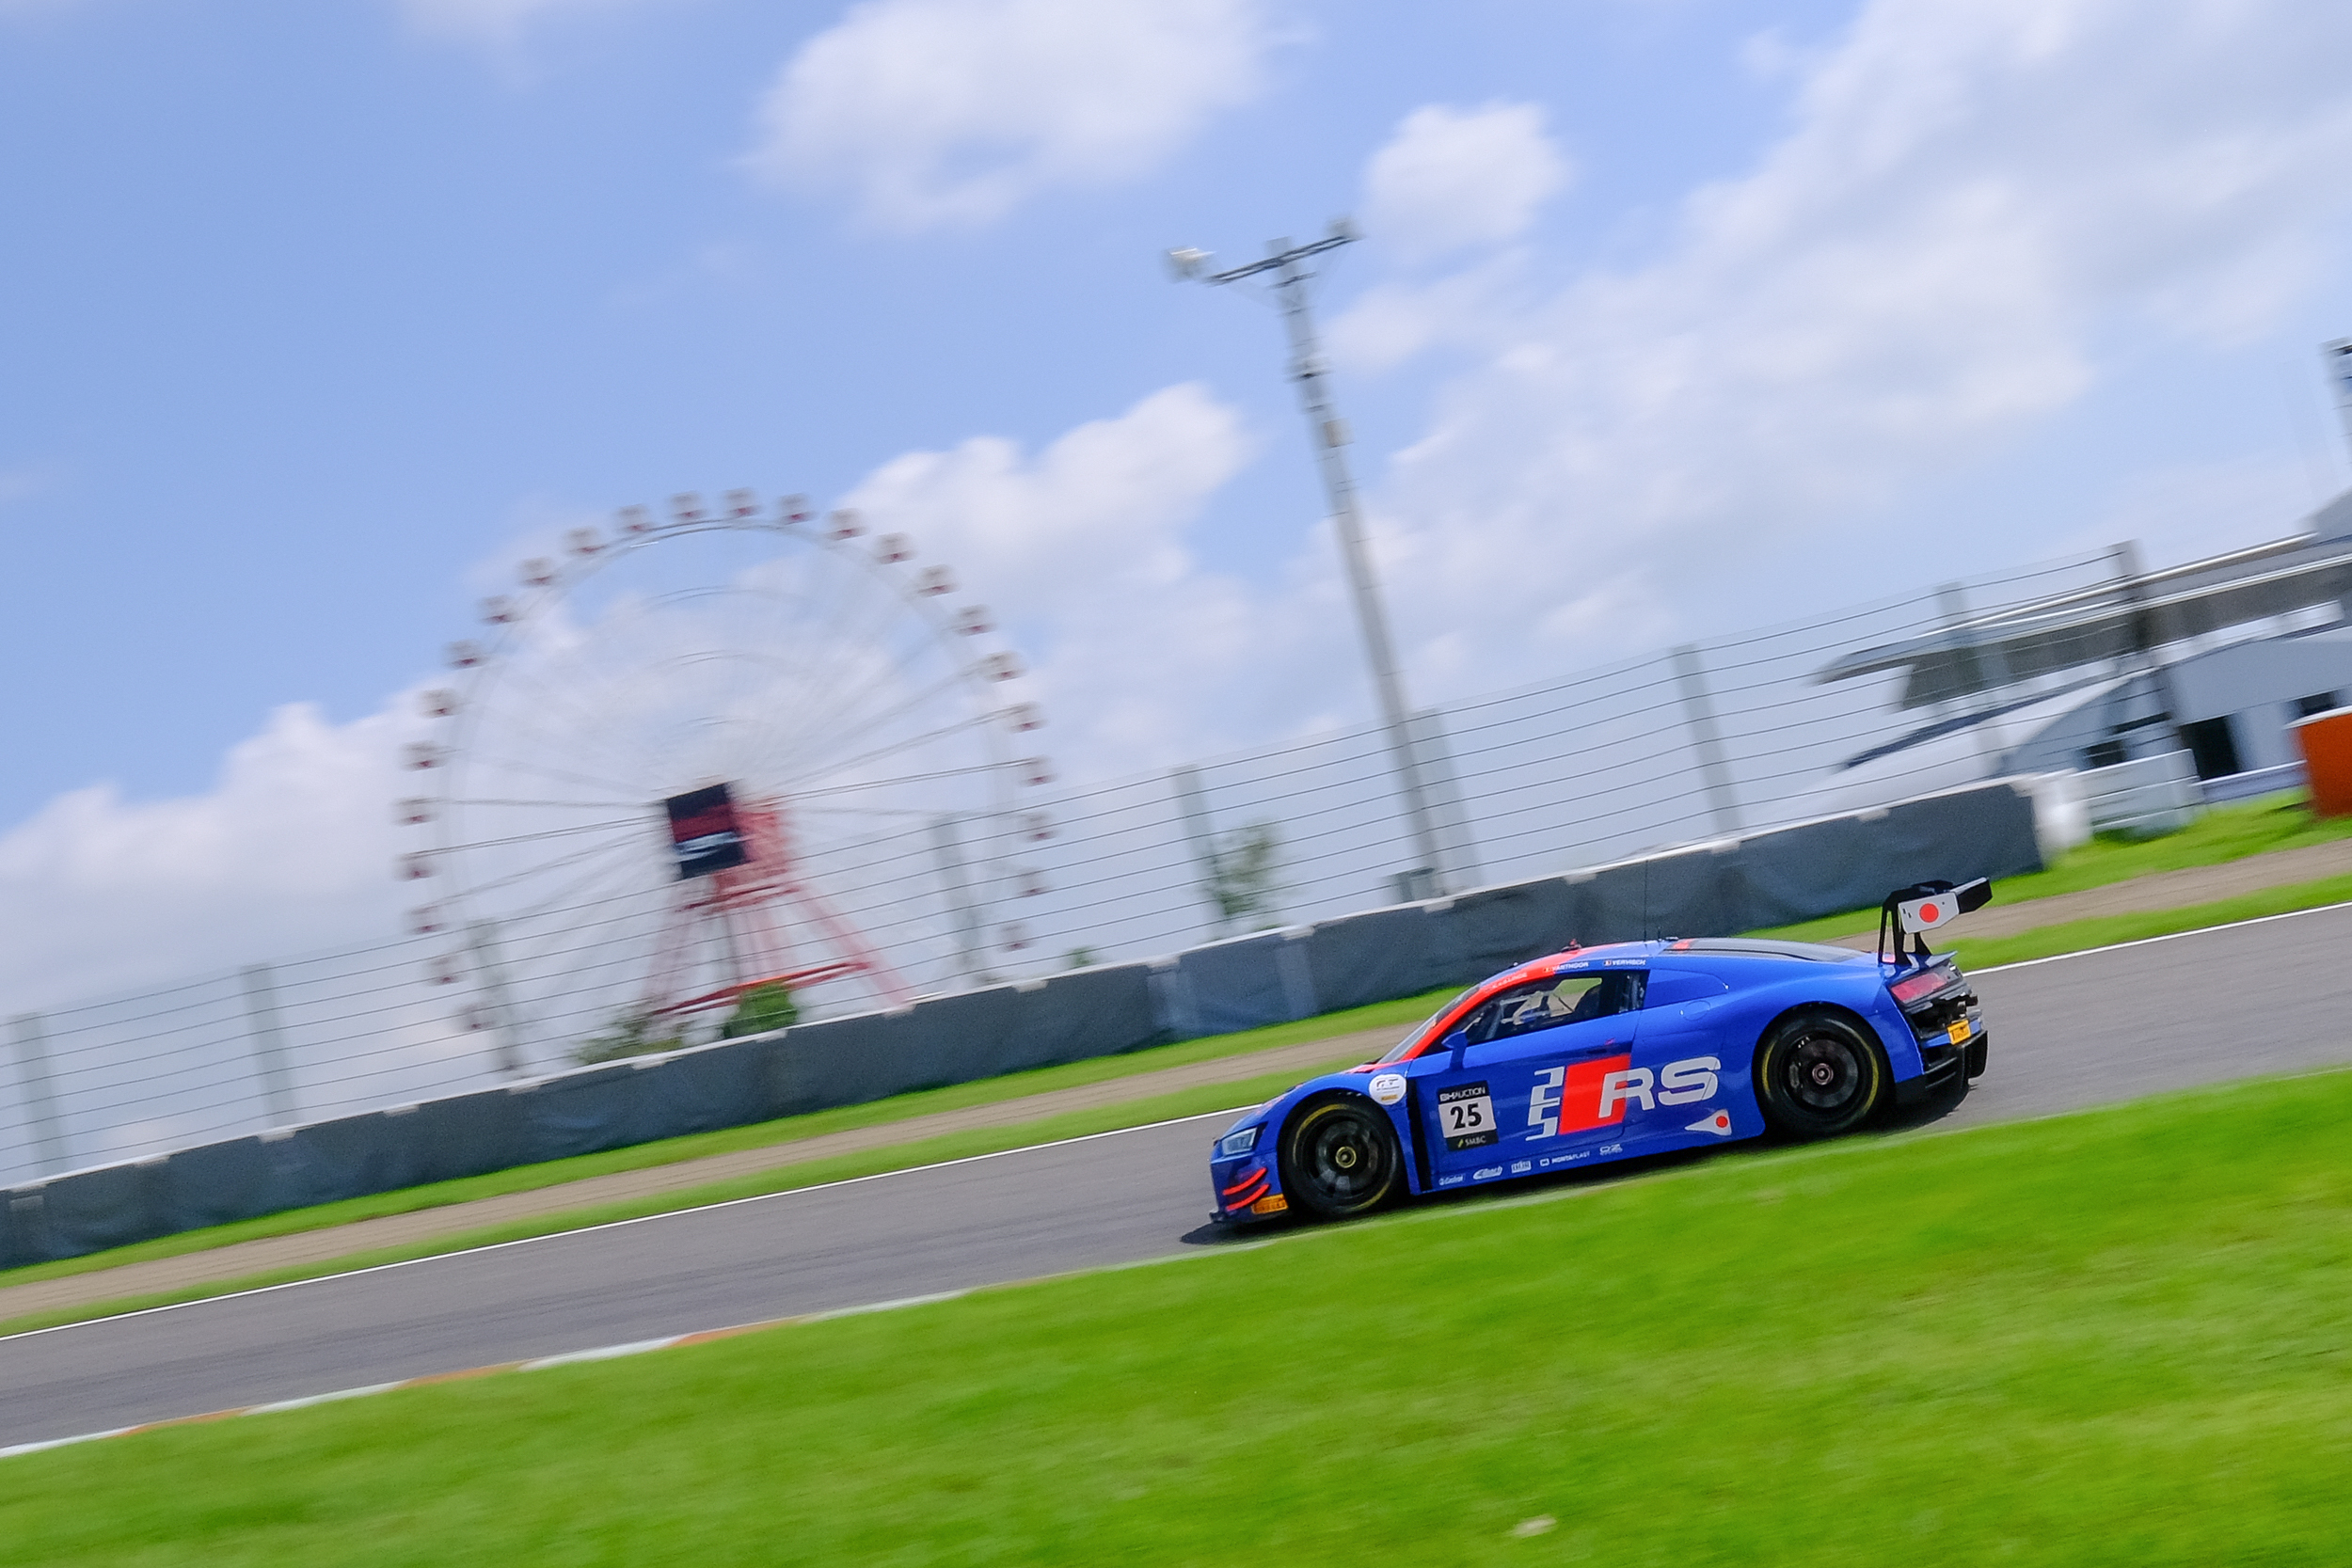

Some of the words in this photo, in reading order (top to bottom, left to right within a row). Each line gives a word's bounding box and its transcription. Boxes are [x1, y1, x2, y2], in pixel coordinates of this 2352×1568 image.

[1597, 1055, 1722, 1118] RS
[1450, 1102, 1483, 1130] 25
[1464, 1135, 1486, 1147] SMBC
